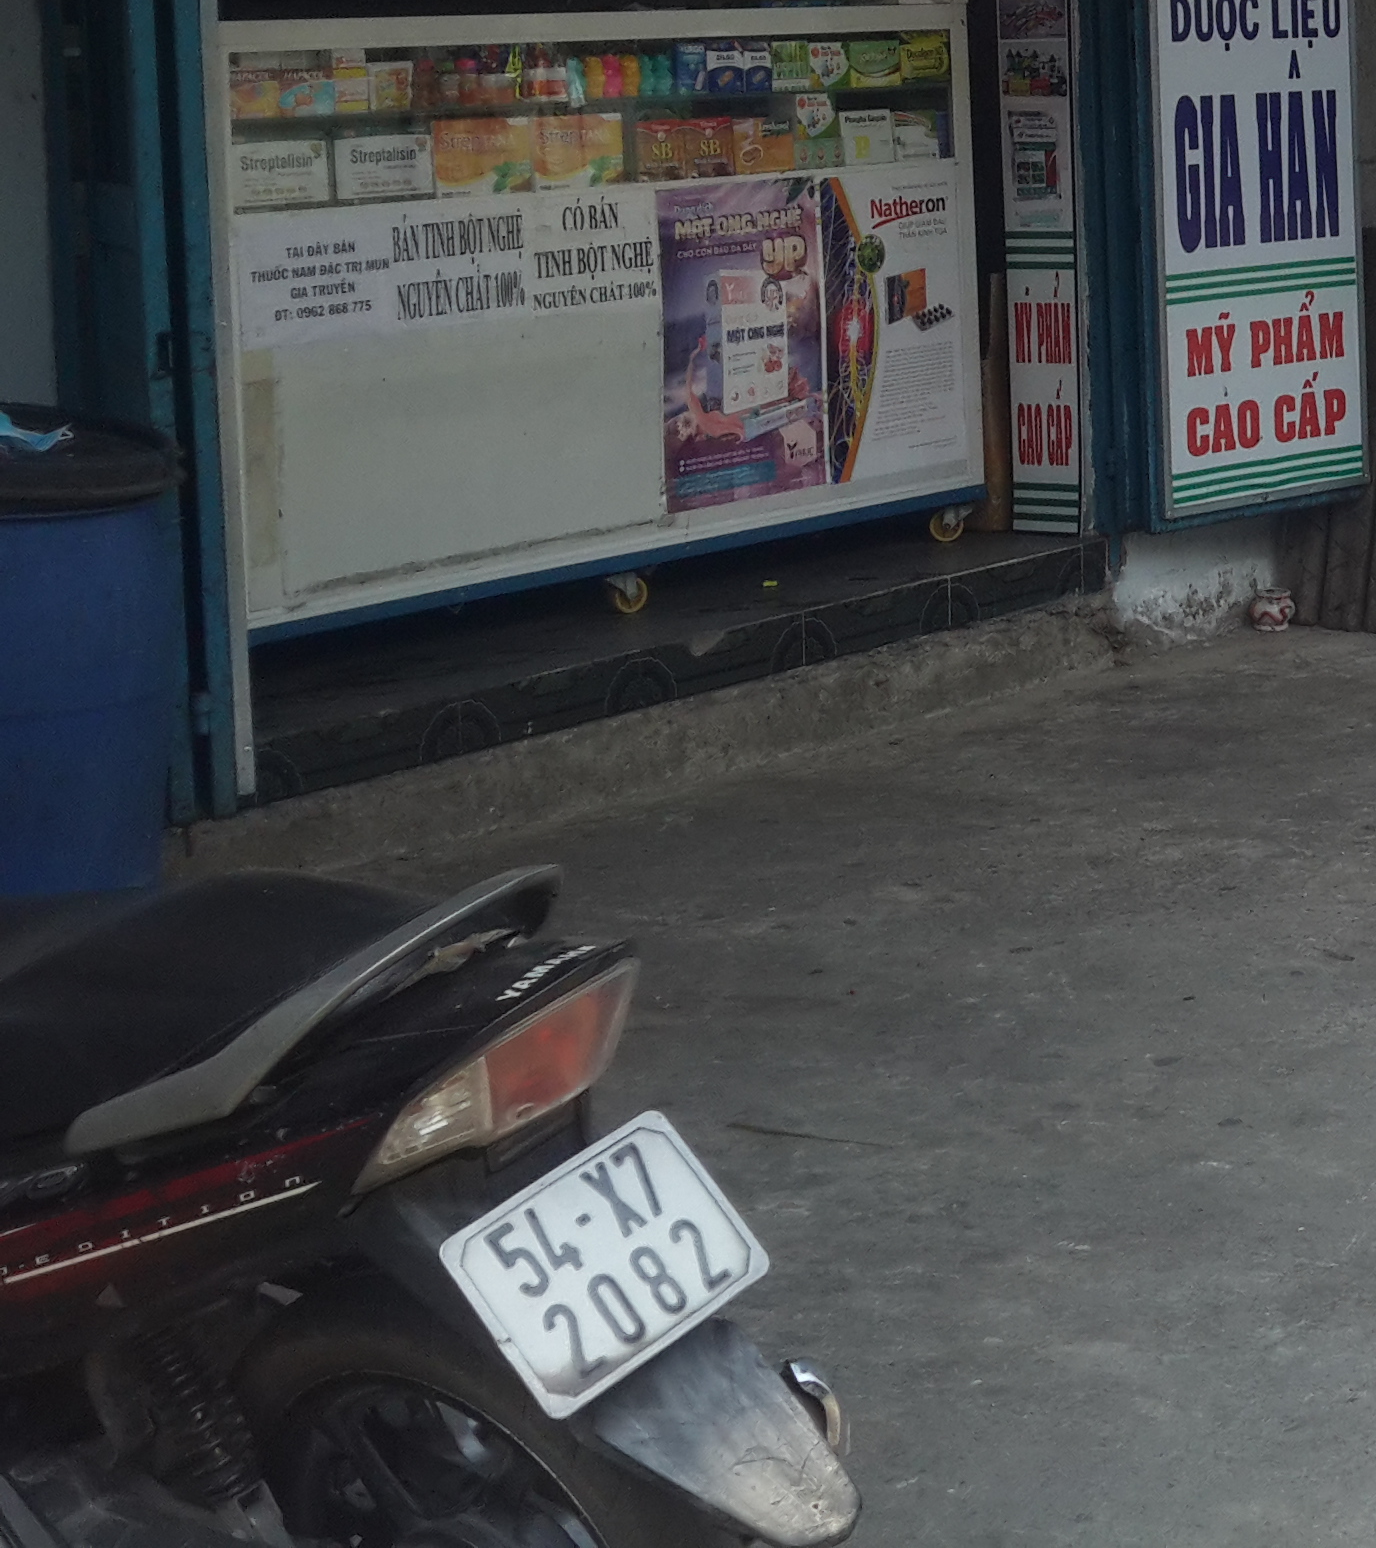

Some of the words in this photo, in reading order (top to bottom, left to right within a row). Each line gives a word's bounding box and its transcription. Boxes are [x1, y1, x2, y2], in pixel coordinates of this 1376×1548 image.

[1172, 90, 1248, 255] GIA
[1254, 48, 1341, 245] HÂN
[561, 198, 585, 232] CÓ
[587, 195, 620, 230] BÁN
[869, 195, 947, 221] Natheron
[391, 213, 420, 263] BÁN
[422, 219, 456, 260] TINH
[458, 213, 485, 265] BỘT
[533, 249, 574, 280] TINH
[576, 241, 609, 281] BỘT
[610, 236, 655, 275] NGHỆ
[396, 268, 453, 321] NGUYÊN
[531, 284, 588, 311] NGUYÊN
[1185, 311, 1236, 379] MỸ
[1249, 290, 1346, 370] PHẨM
[1016, 402, 1043, 467] CAO
[1185, 401, 1261, 458] CAO
[1273, 370, 1347, 445] CẤP
[482, 1142, 663, 1298] 54-X7
[541, 1218, 733, 1380] 2082
